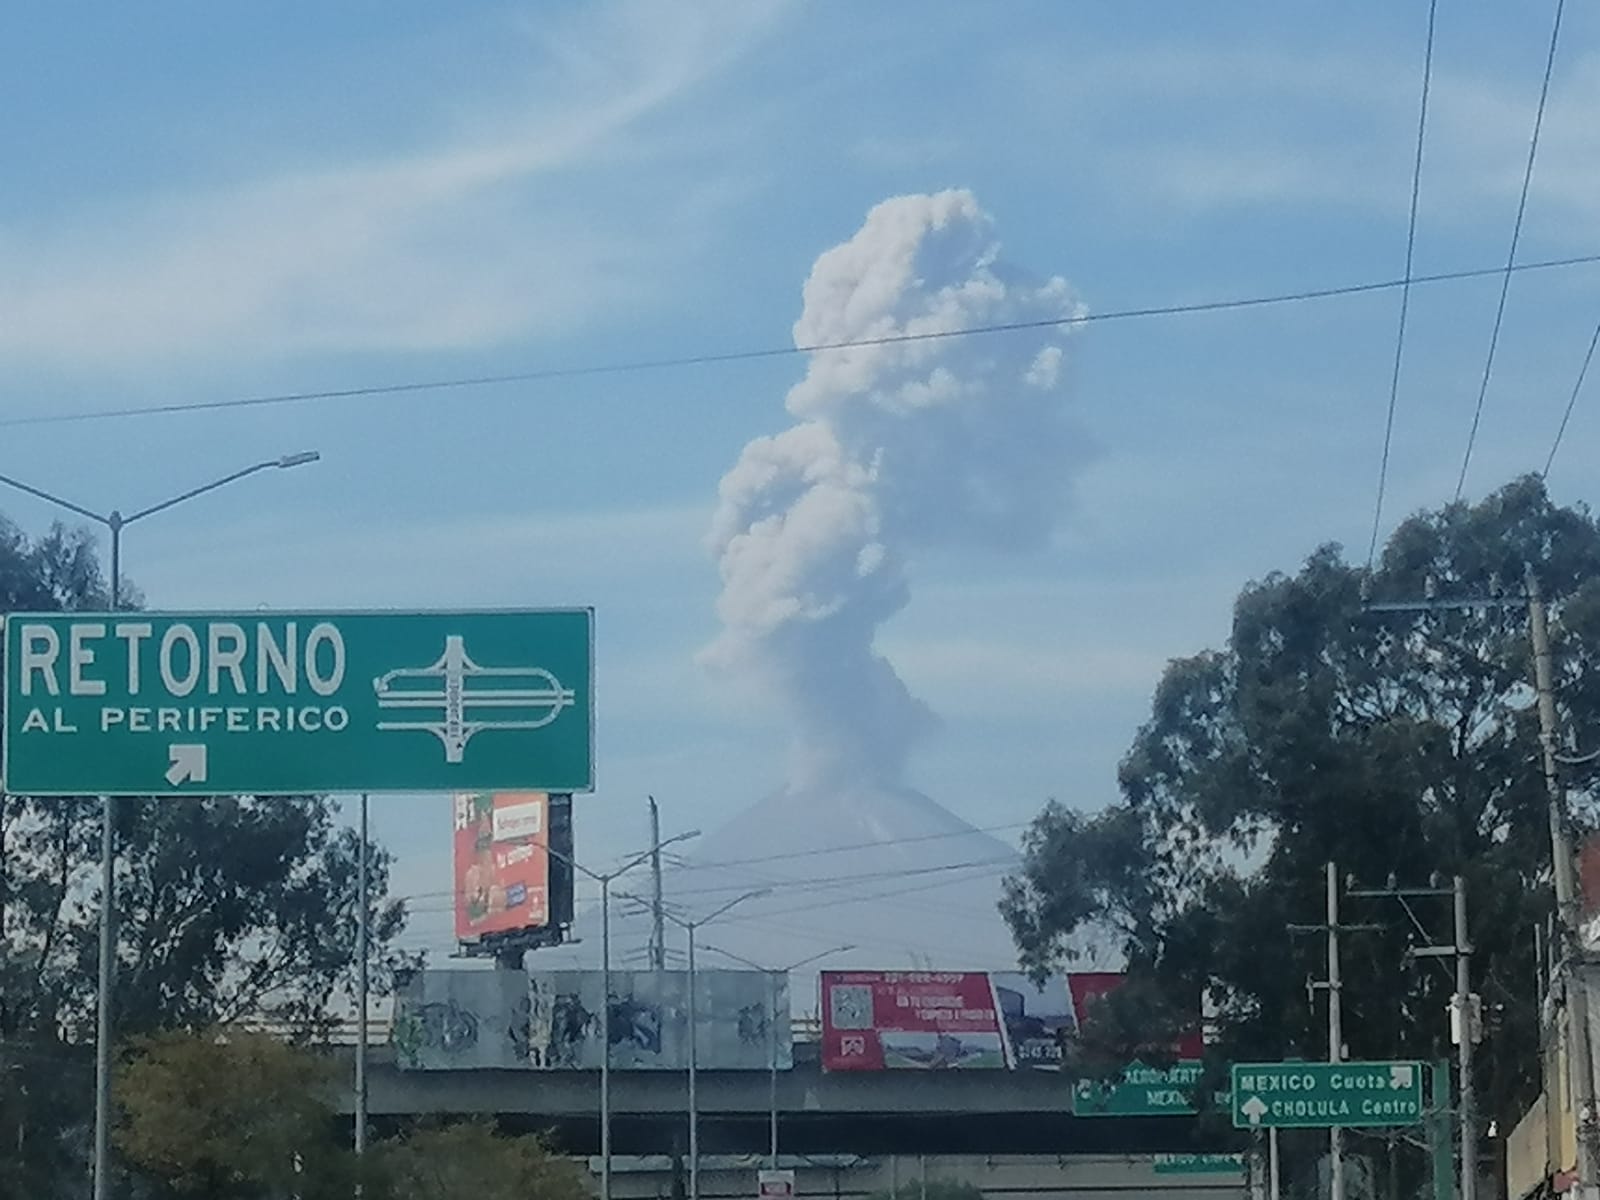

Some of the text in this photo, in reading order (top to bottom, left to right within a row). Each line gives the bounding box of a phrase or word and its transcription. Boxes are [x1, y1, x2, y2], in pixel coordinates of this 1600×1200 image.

[20, 622, 347, 697] RETORNO
[21, 706, 349, 732] AL PERIFERICO
[1240, 1074, 1386, 1091] MEXICO Cuota
[1271, 1098, 1417, 1117] CHOLULA Centro
